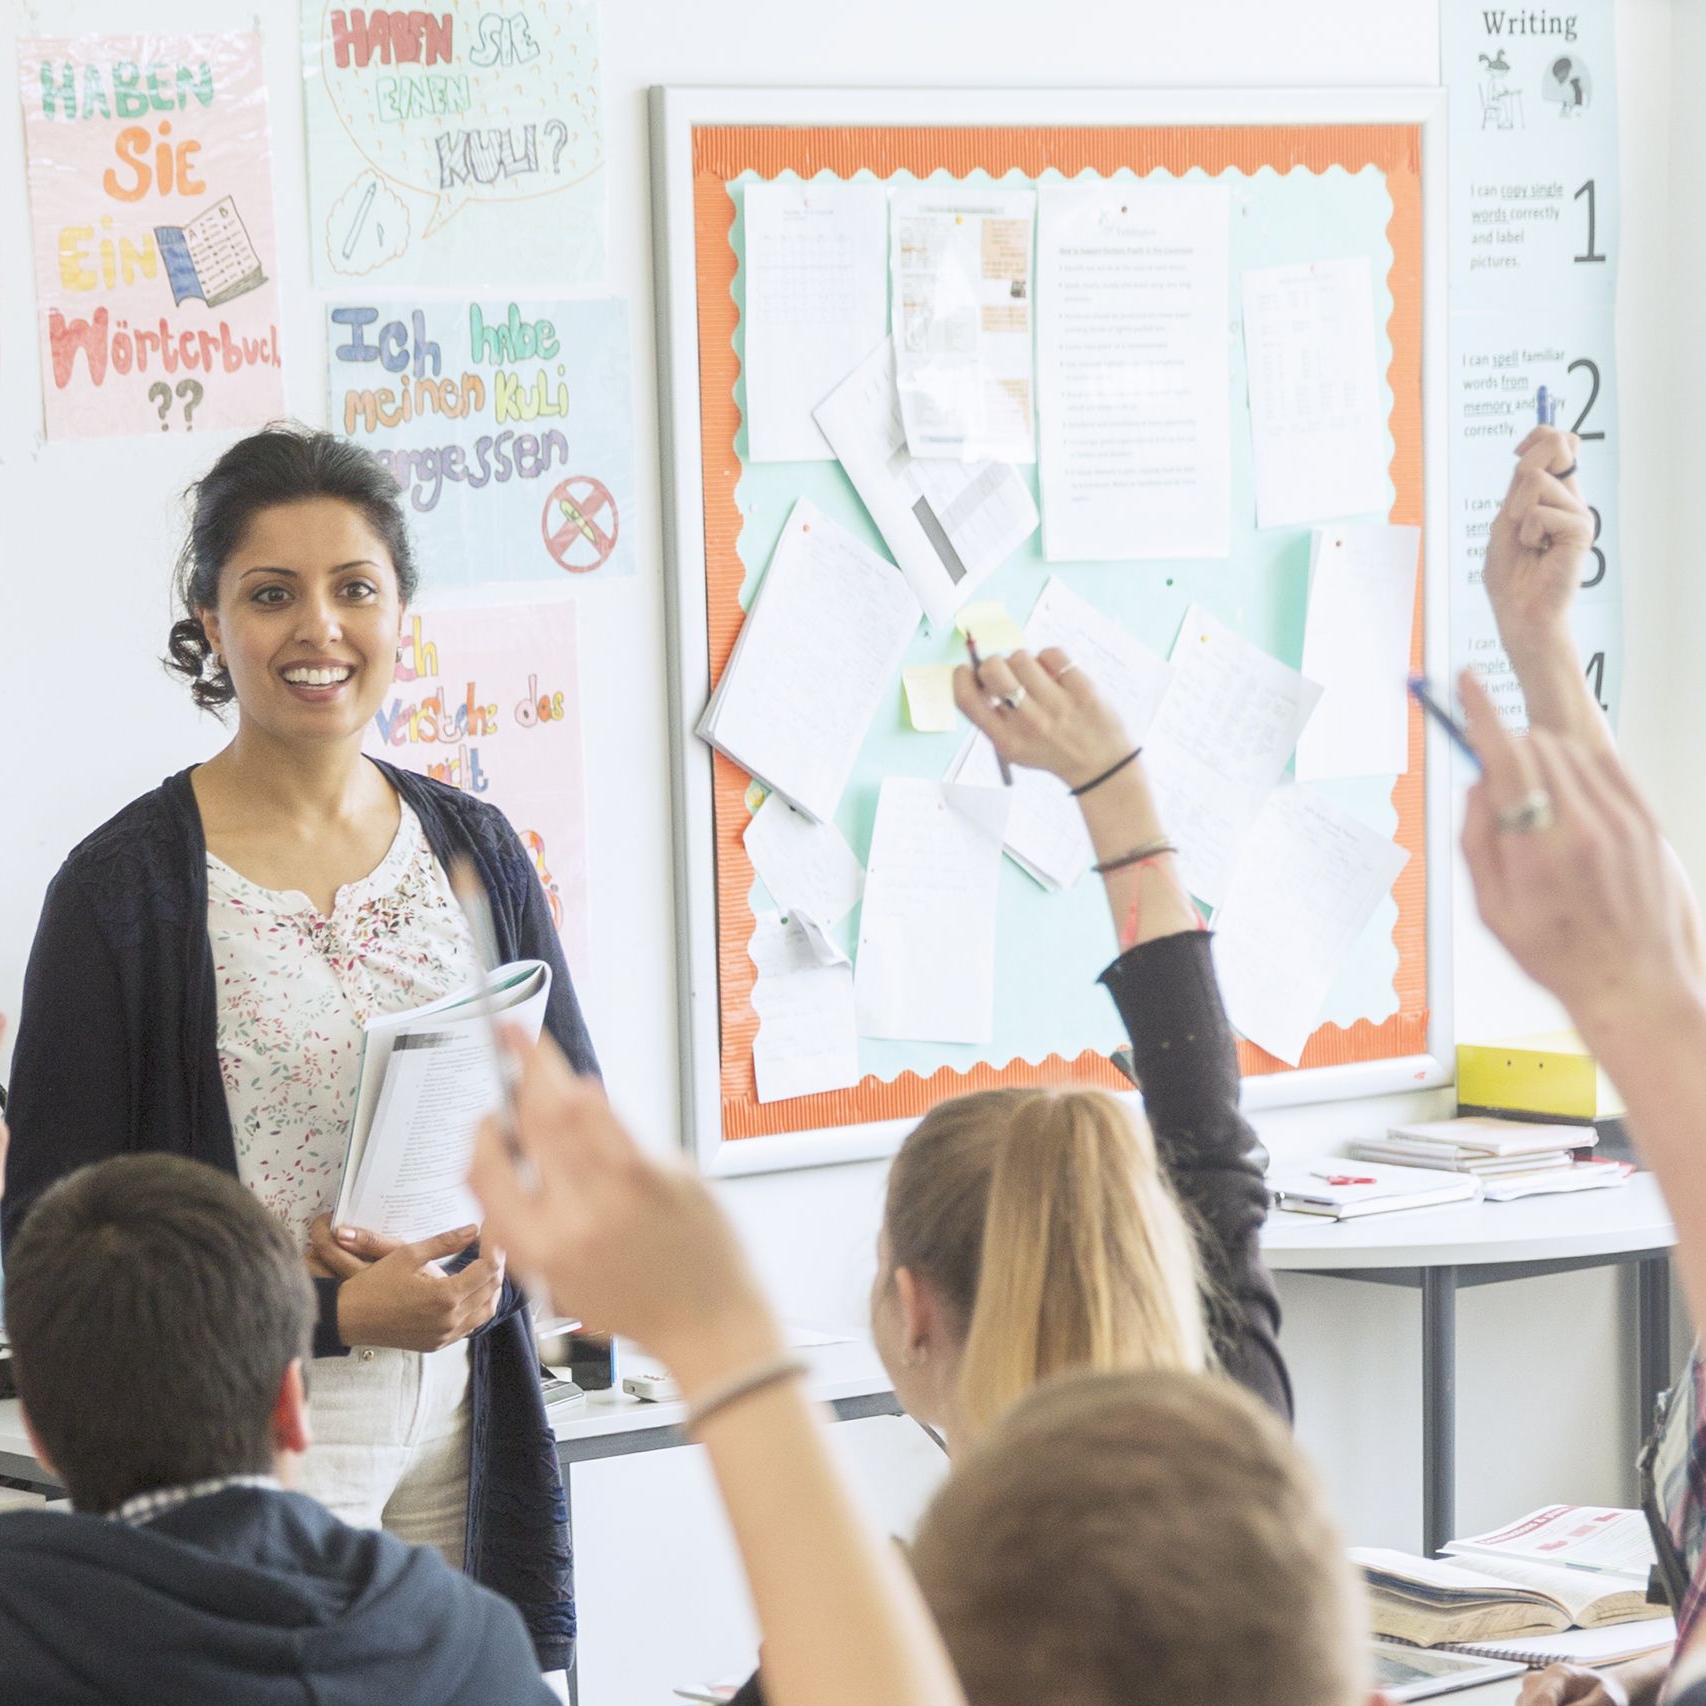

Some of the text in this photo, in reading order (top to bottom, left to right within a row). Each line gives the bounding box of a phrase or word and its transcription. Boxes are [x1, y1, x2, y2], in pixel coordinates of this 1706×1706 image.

[330, 9, 453, 69] HABEN
[1481, 8, 1578, 43] Writing
[39, 59, 214, 121] HABEN
[1471, 203, 1560, 224] words correctly
[1478, 185, 1498, 198] can
[1500, 185, 1527, 199] copy
[1471, 228, 1525, 245] and label
[1574, 178, 1606, 263] 1
[48, 306, 282, 390] Wörterbuch
[331, 302, 561, 379] Ich habe
[1469, 354, 1490, 368] can
[1492, 350, 1519, 368] spell
[148, 378, 204, 432] ??
[344, 371, 486, 434] meinen
[1462, 373, 1529, 391] words from
[1463, 399, 1512, 416] memory
[1567, 358, 1606, 441] 2
[373, 428, 570, 513] ergessen
[1471, 499, 1493, 511] can
[393, 614, 439, 684] ch
[513, 673, 565, 729] das
